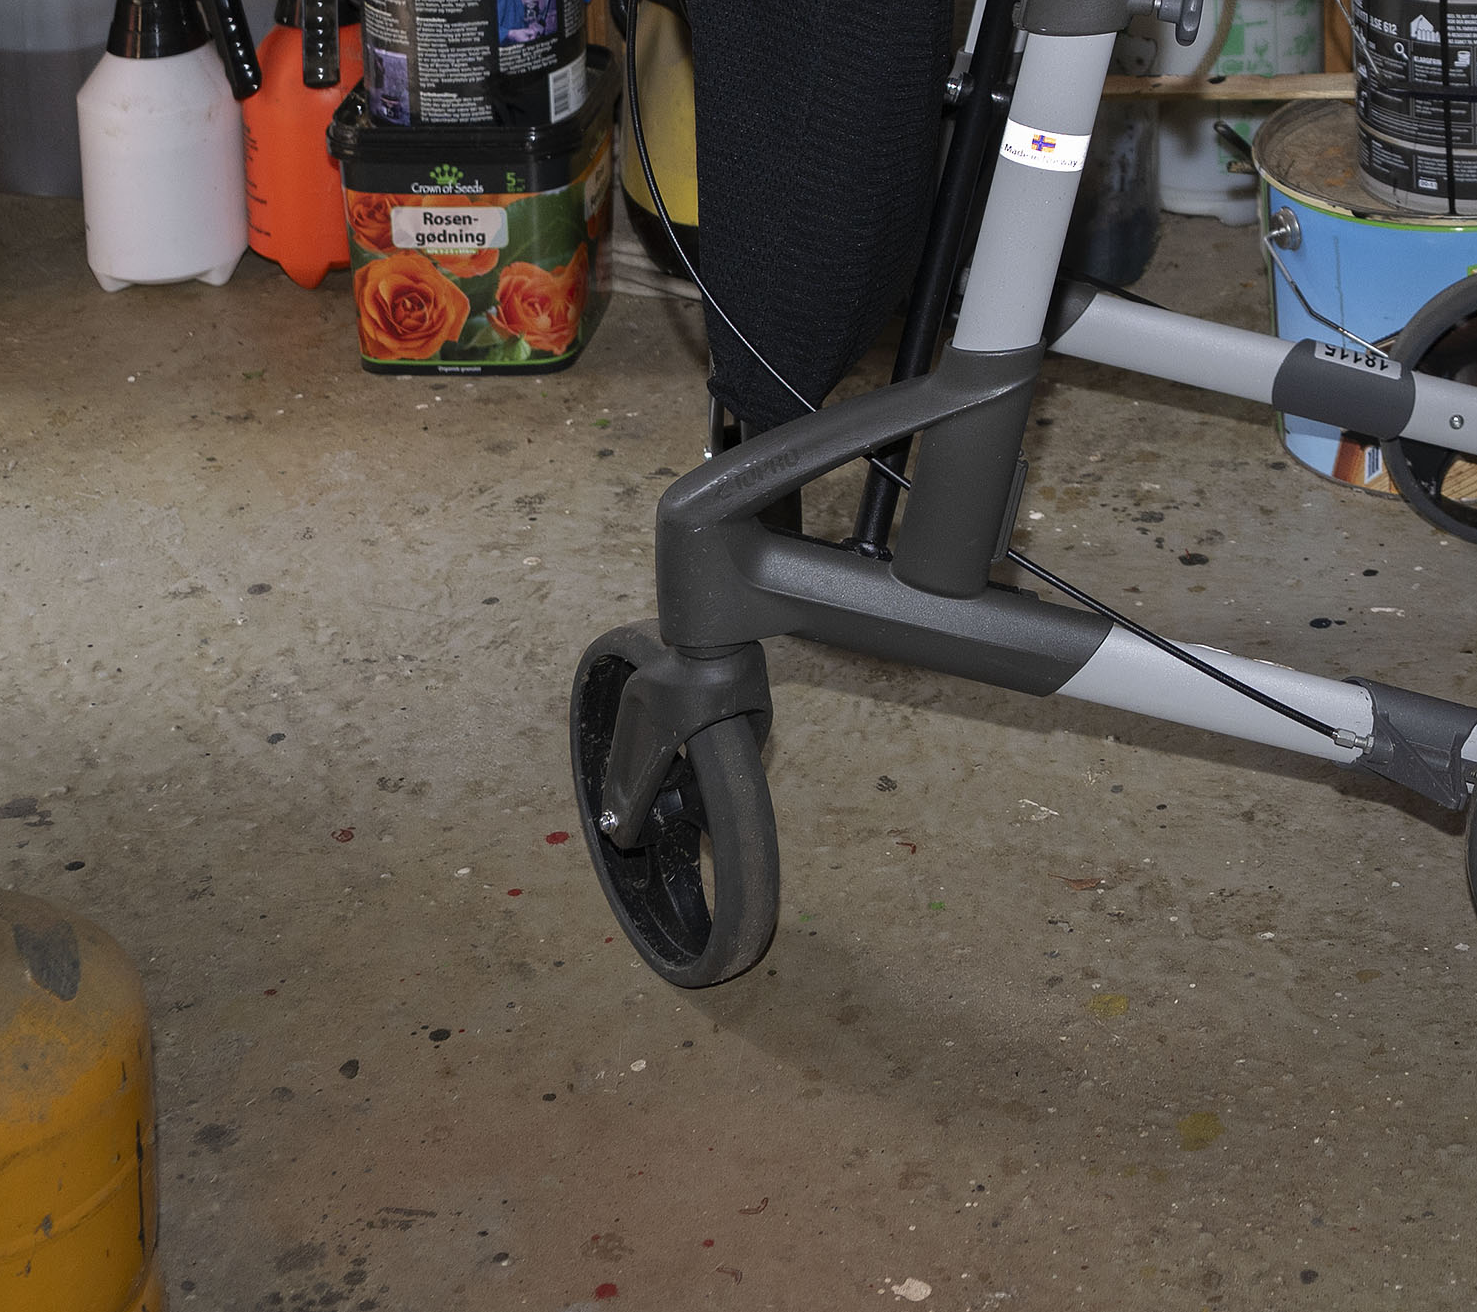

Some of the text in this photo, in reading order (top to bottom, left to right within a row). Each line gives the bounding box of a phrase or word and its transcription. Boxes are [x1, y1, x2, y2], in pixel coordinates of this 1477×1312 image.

[411, 180, 484, 194] Crown of Seeds
[423, 211, 479, 226] Rosen-
[415, 229, 487, 248] gødning
[1324, 343, 1390, 373] 18115
